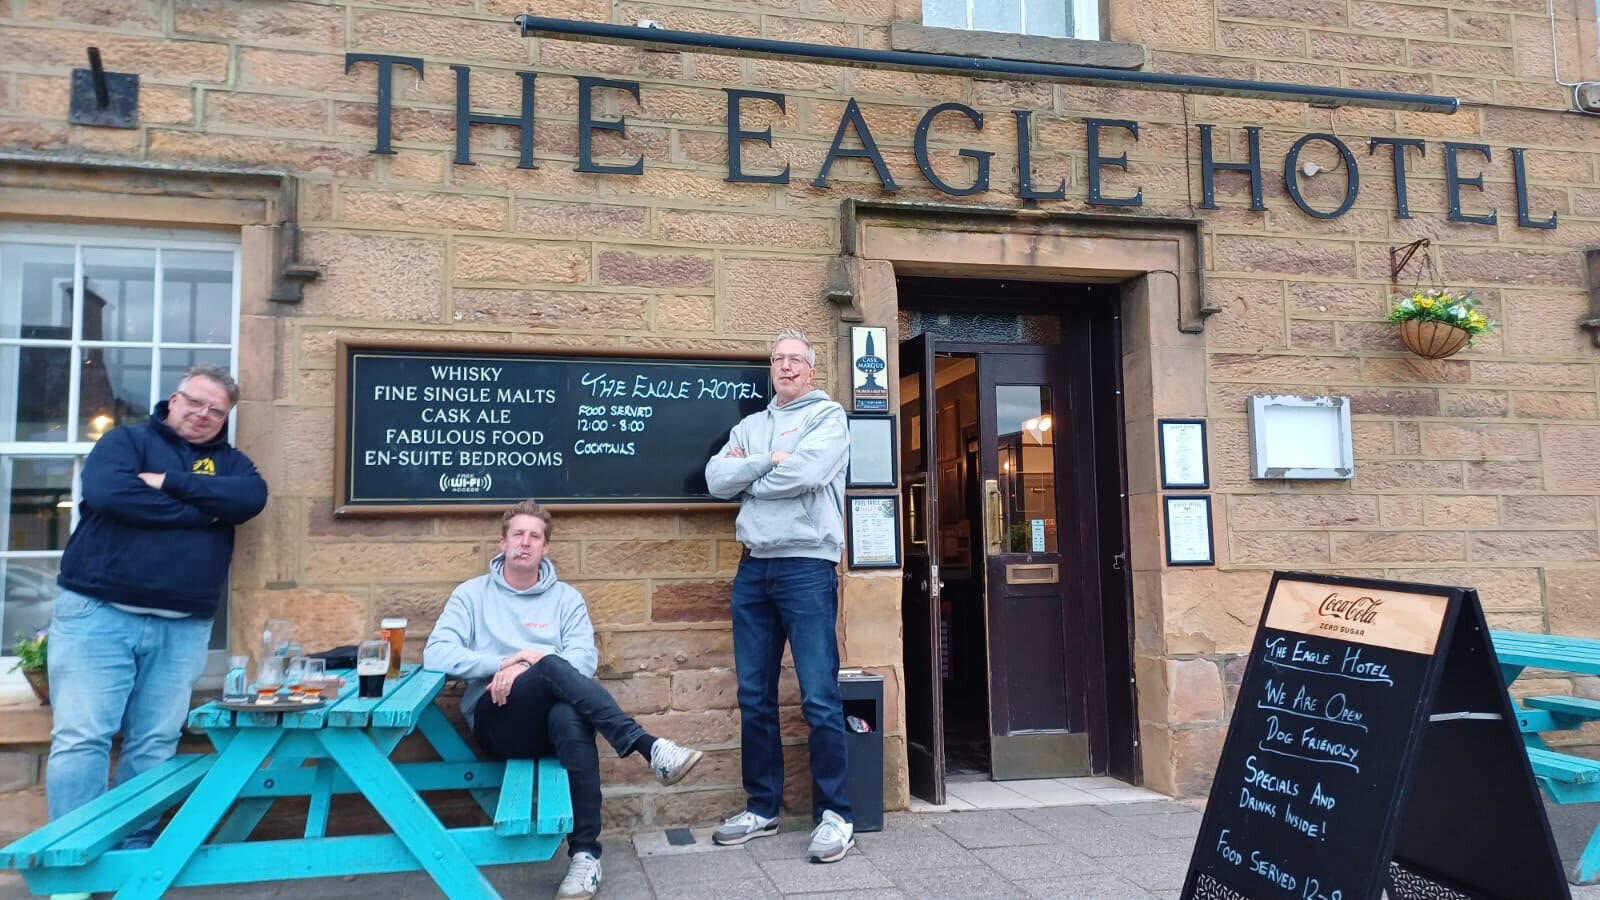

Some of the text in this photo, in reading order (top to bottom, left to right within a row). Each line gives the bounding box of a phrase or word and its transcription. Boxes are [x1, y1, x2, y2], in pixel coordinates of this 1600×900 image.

[345, 52, 1558, 230] THE EAGLE HOTEL
[431, 365, 502, 381] WHISKY
[374, 385, 556, 404] FINE SINGLE MALTS
[581, 372, 763, 400] THE EAGLE HOTEL
[421, 408, 511, 424] CASK ALE
[578, 404, 653, 418] FOOD SERVED
[386, 429, 544, 445] FABULOUS FOOD
[577, 419, 609, 432] 12:00
[619, 419, 645, 432] 8:00
[365, 450, 563, 466] EN-SUITE BEDROOMS
[1320, 622, 1366, 637] ZERO SUGAR
[1265, 637, 1391, 678] THE EAGLE HOTEL
[1265, 679, 1363, 721] WE ARE OPEN
[1266, 715, 1360, 762] DOG FRIENDLY
[1244, 755, 1336, 810] SPECIALS AND
[1239, 787, 1277, 818] DRINKS
[1216, 829, 1243, 865] FOOD
[1249, 851, 1297, 890] SERVED
